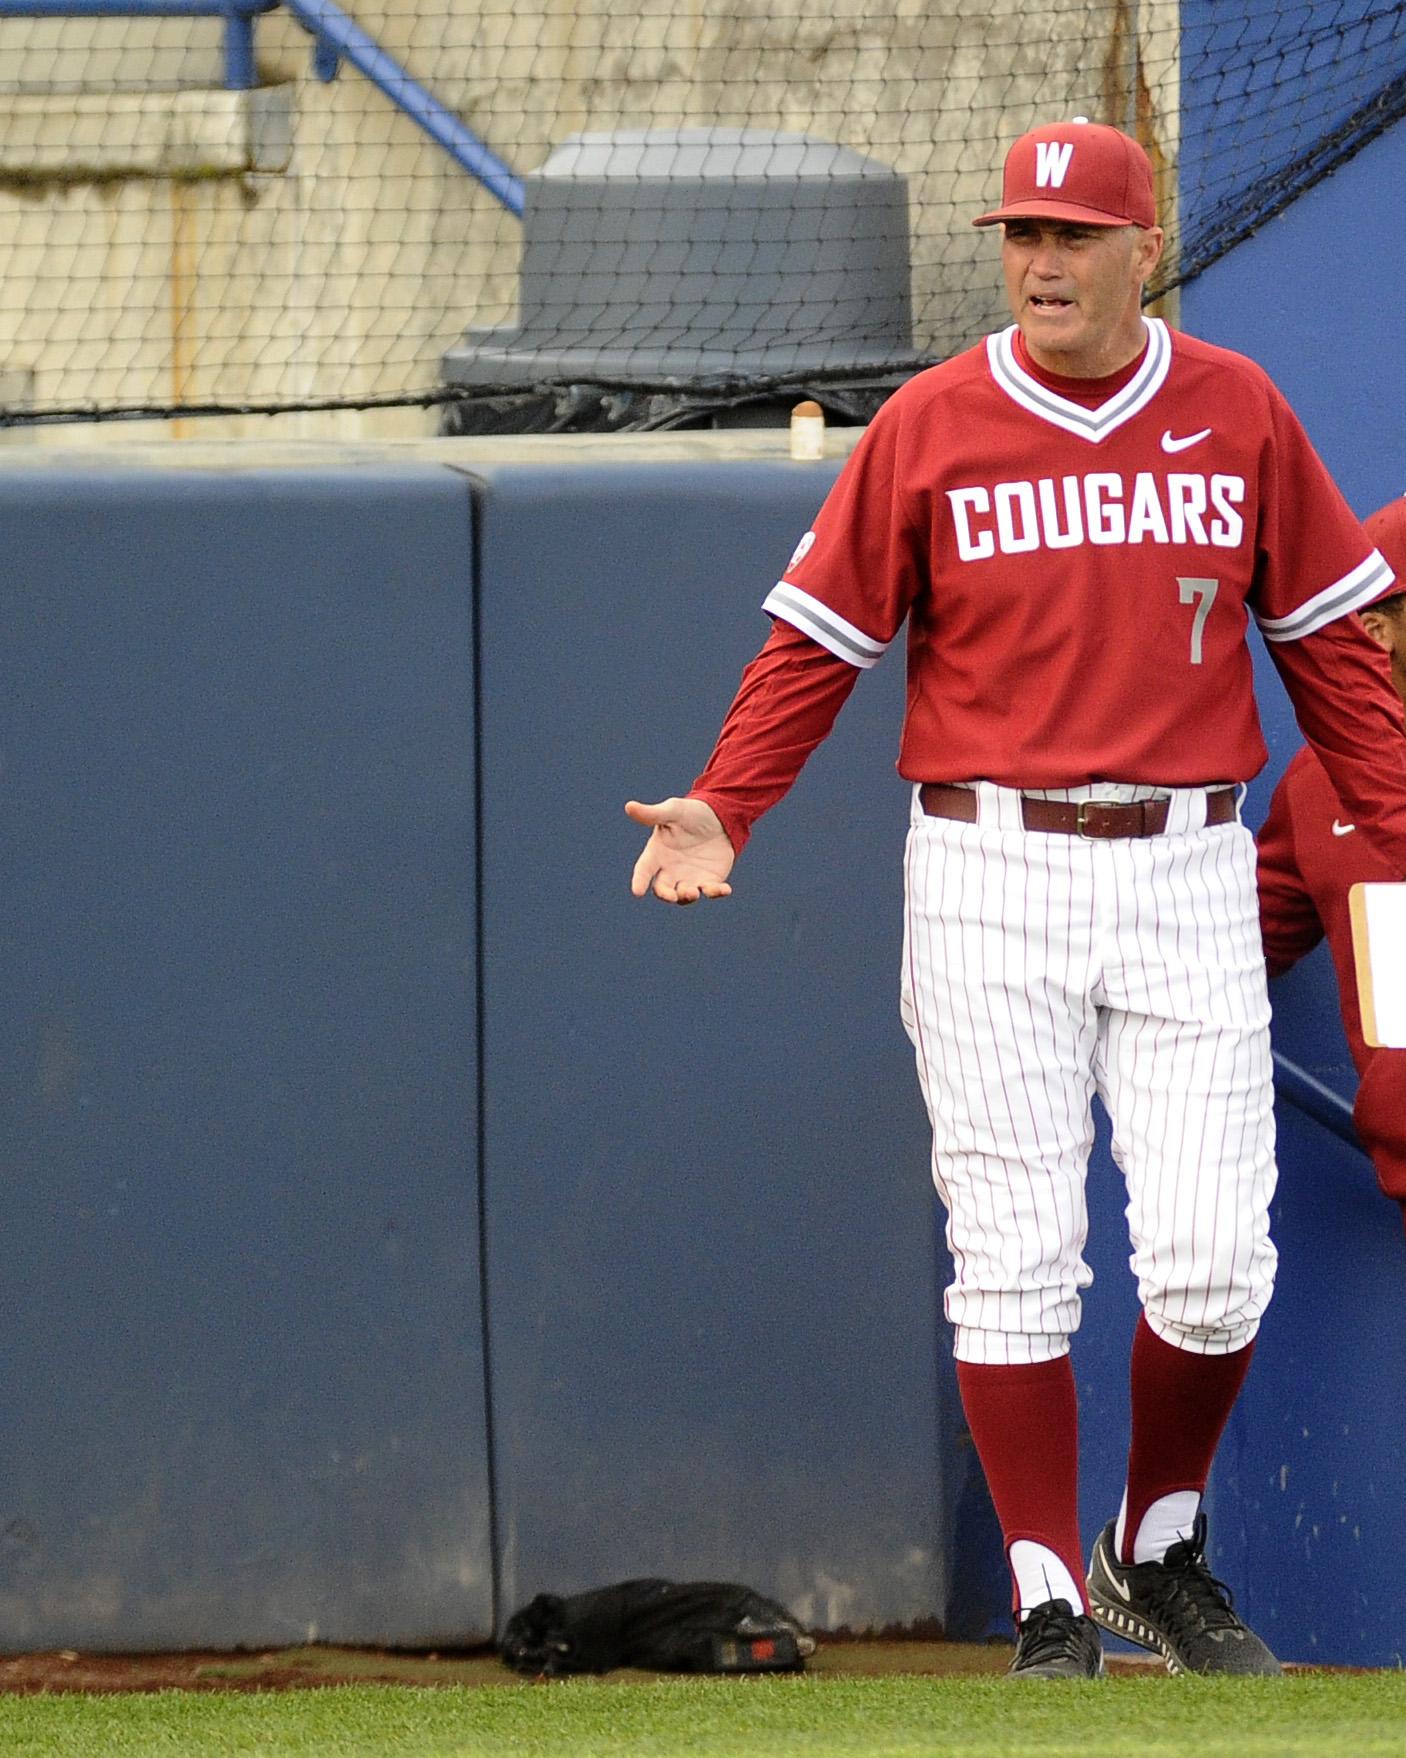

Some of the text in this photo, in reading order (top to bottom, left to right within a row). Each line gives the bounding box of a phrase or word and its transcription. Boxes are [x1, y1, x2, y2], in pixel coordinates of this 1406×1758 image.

[1035, 141, 1074, 188] W
[945, 472, 1245, 562] COUGARS
[1176, 577, 1219, 664] 7
